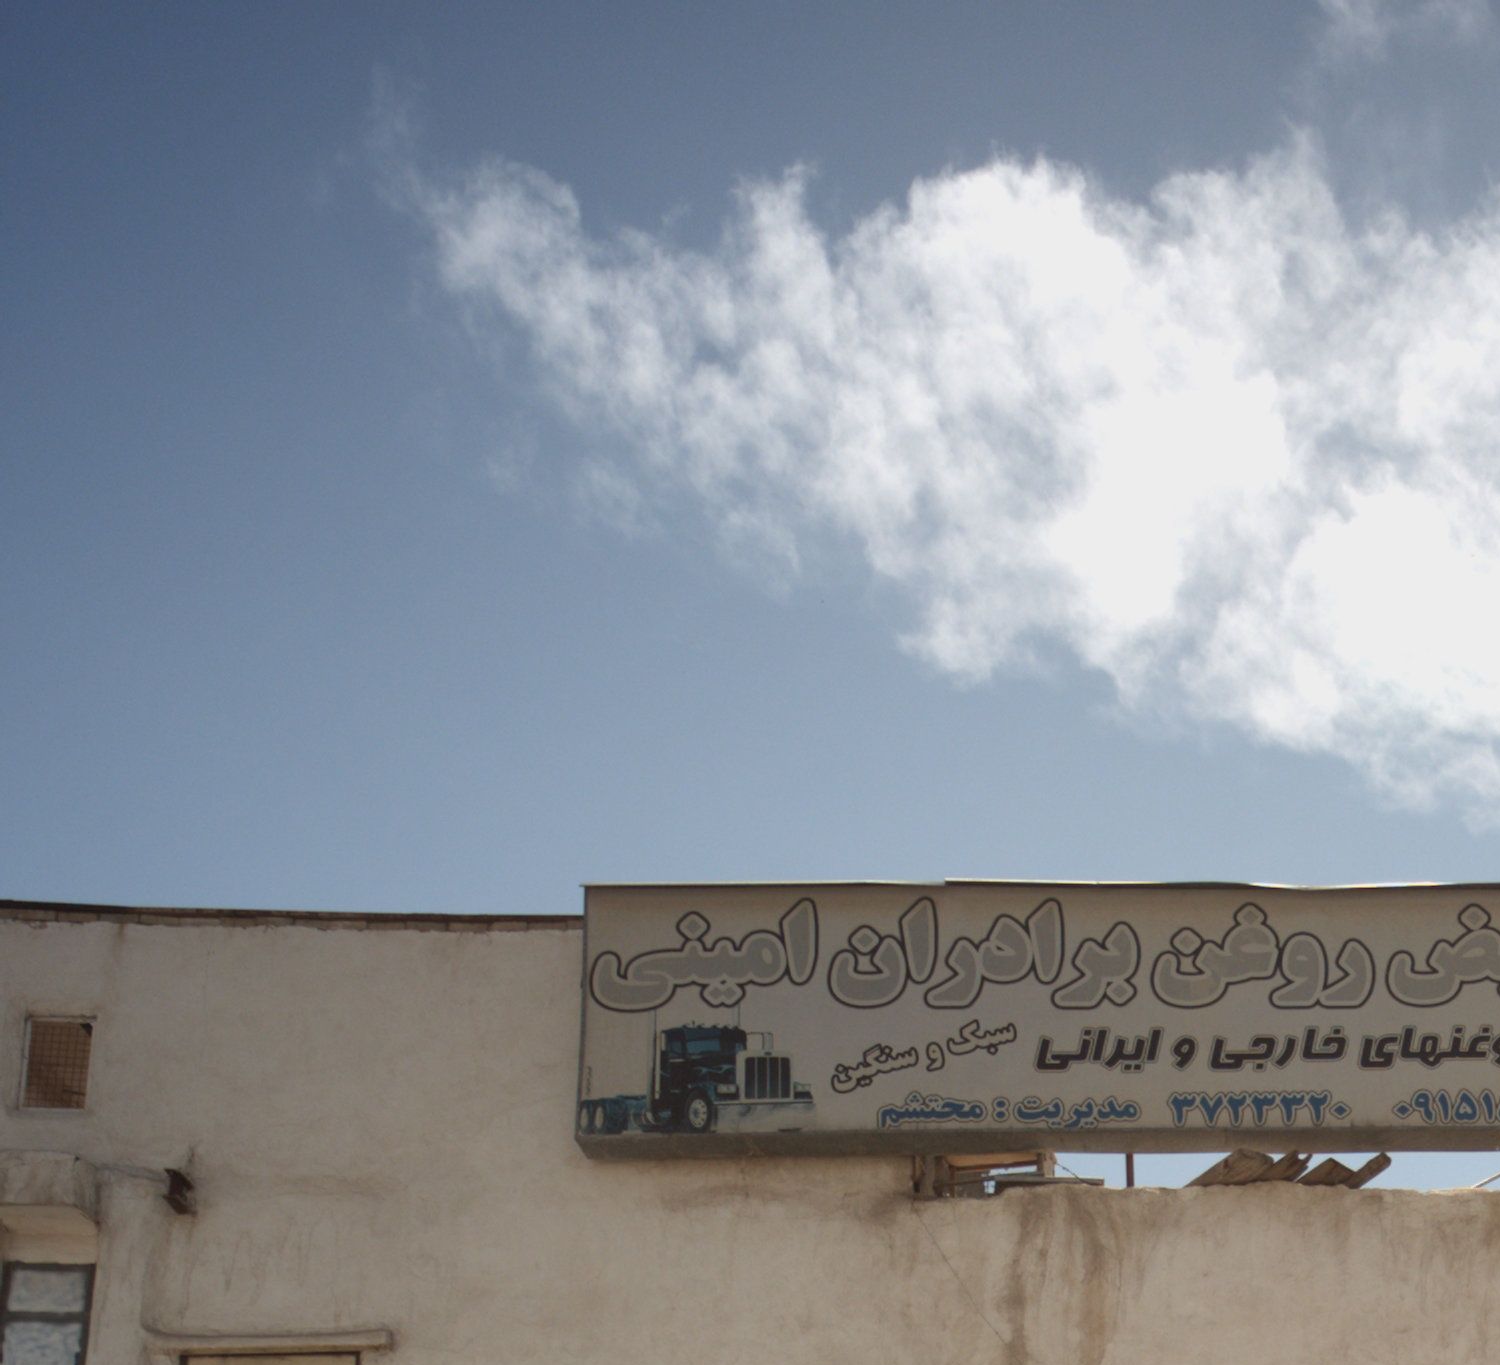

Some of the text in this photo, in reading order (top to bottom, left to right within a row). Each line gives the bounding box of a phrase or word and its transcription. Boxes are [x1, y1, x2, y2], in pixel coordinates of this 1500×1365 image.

[589, 897, 819, 1013] امینی
[828, 896, 1141, 1010] برادران
[1150, 901, 1376, 1009] روغن
[830, 1018, 1018, 1095] سبک و سنگین
[1034, 1024, 1164, 1073] ایرانی
[1171, 1034, 1199, 1069] و
[1208, 1022, 1350, 1072] خارجی
[876, 1091, 984, 1129] محتشم
[1015, 1094, 1141, 1129] مدیریت
